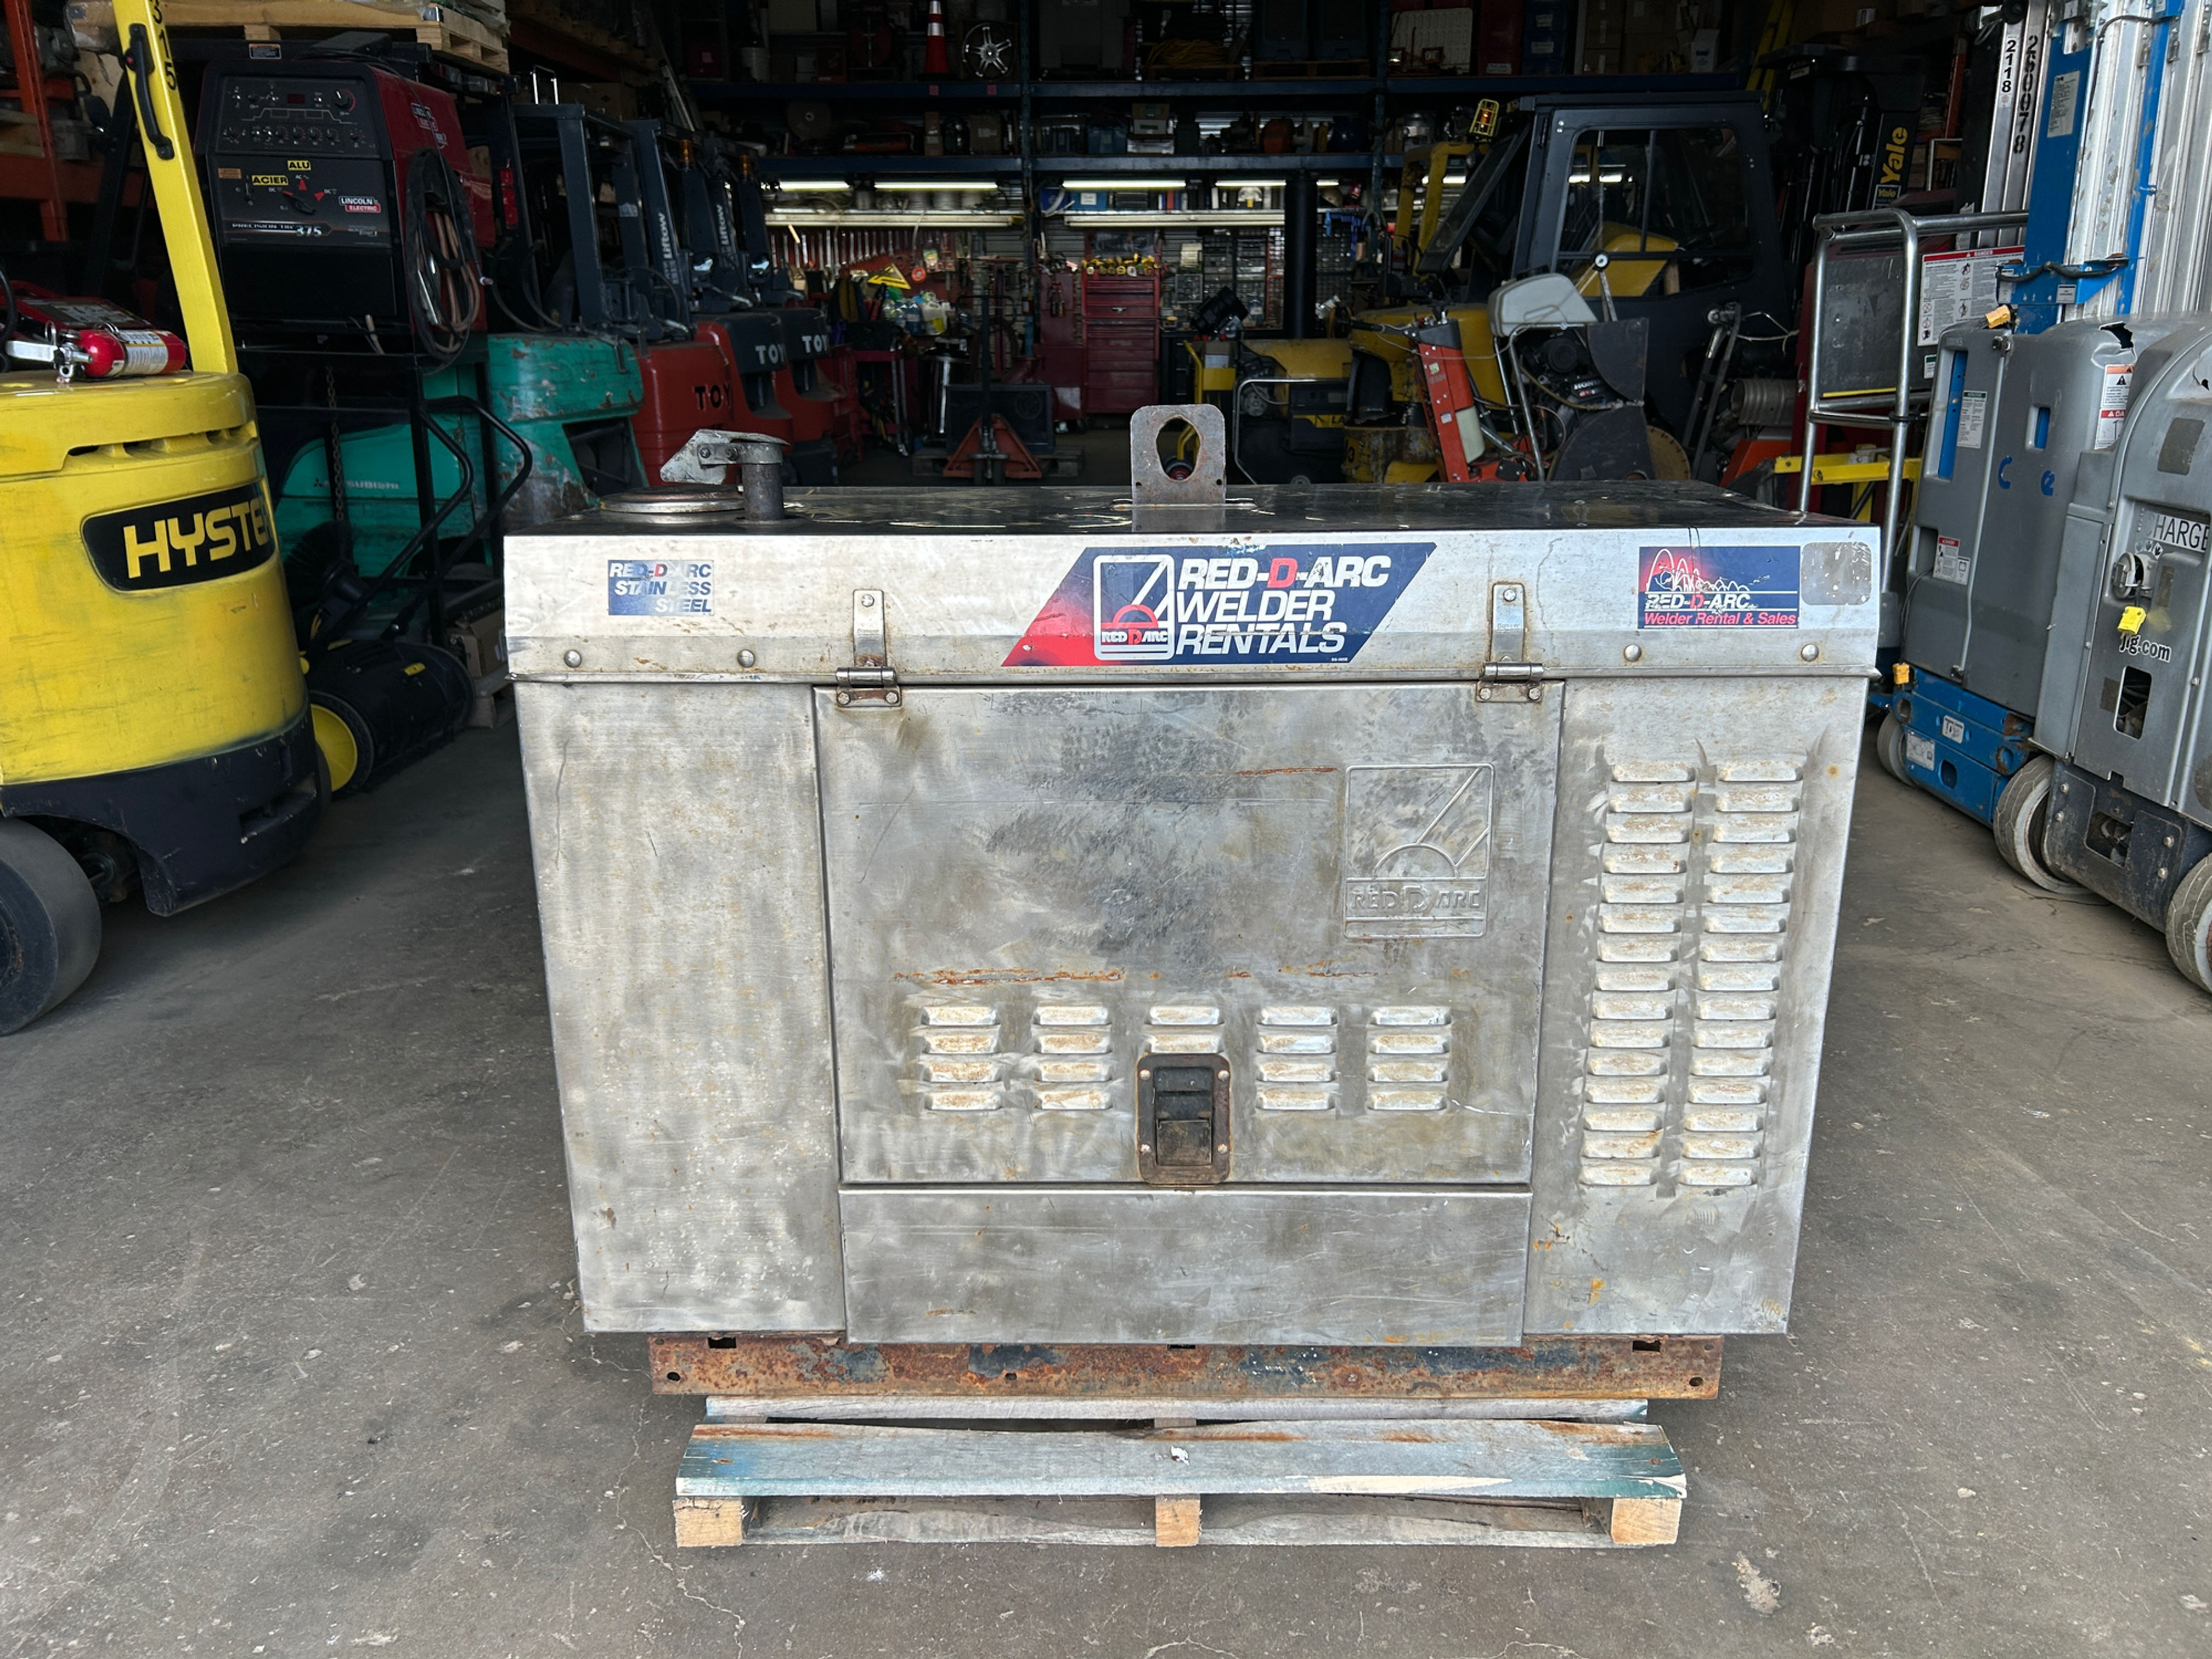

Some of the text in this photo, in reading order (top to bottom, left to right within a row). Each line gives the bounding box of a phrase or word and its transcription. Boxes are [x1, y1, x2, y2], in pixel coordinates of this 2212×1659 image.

[2002, 40, 2017, 93] 2118
[1880, 127, 1908, 184] Yale
[296, 225, 322, 237] 375
[123, 498, 270, 579] HYSTE
[2147, 514, 2210, 550] HARGE
[610, 563, 712, 578] RED-DRC
[1178, 555, 1391, 590] RED-D-ARC
[614, 580, 712, 595] STAINLESS
[654, 598, 712, 613] STEEL
[1176, 590, 1335, 623] WELDER
[1645, 612, 1796, 625] Welder Rental & Sales
[1102, 631, 1128, 642] RED
[1176, 622, 1347, 654] RENTALS
